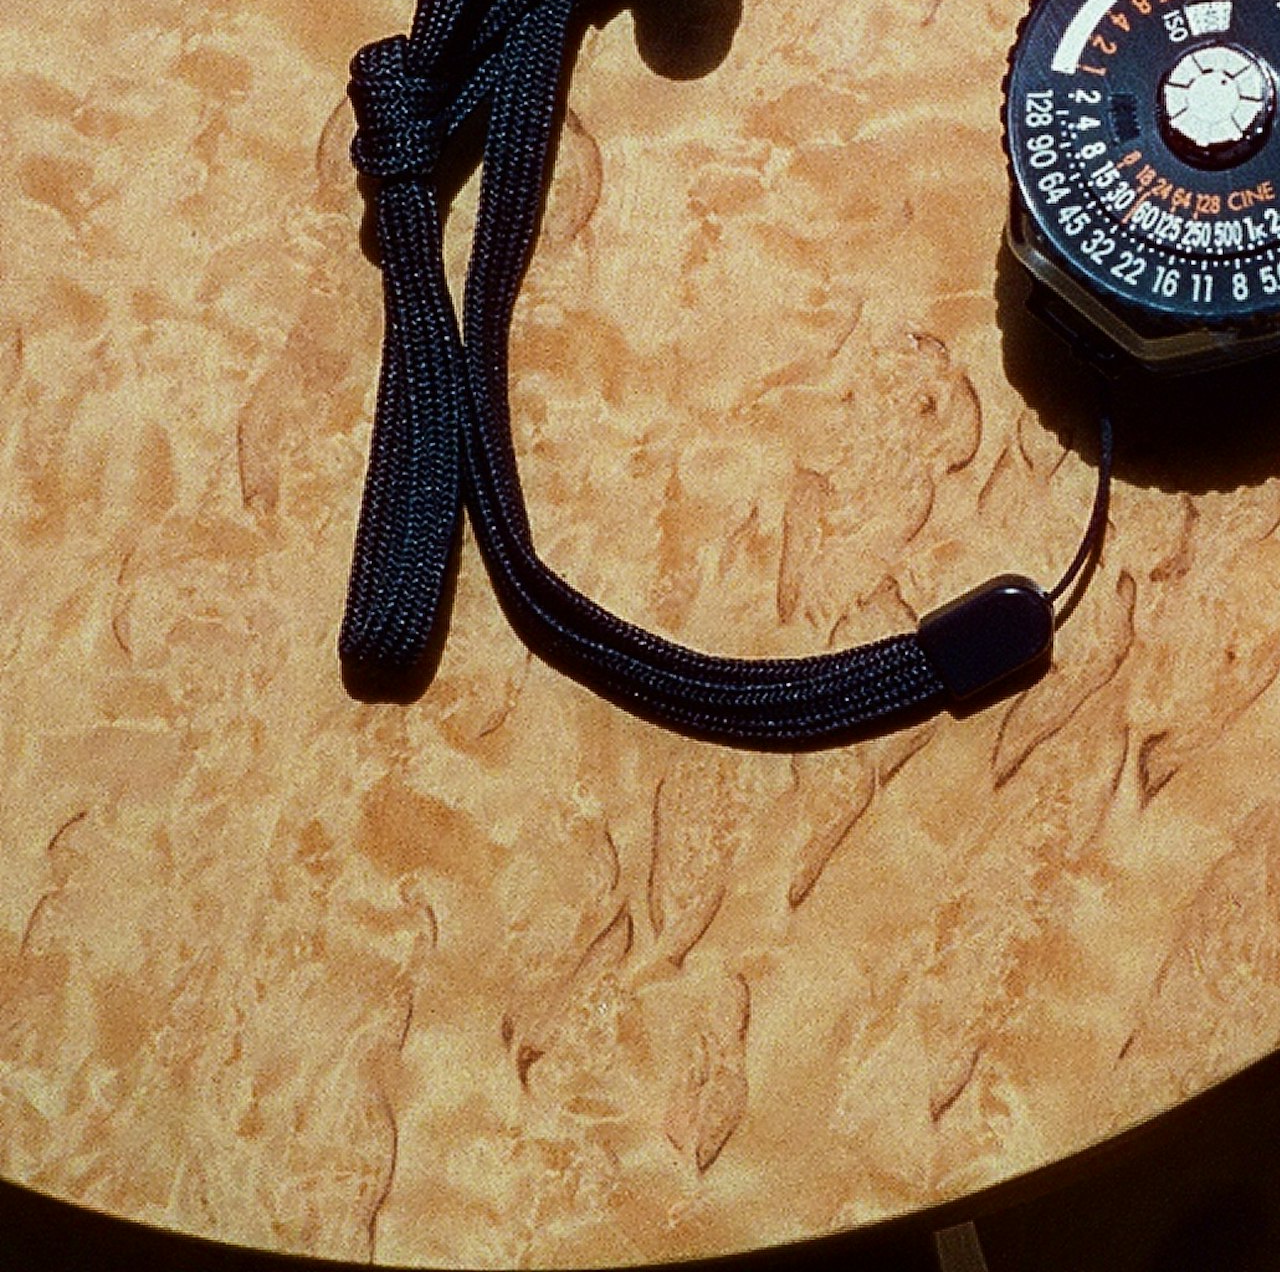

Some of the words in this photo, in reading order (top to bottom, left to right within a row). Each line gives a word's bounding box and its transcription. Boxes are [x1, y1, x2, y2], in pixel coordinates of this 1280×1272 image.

[1092, 34, 1118, 55] 2
[1108, 12, 1132, 32] 4
[1162, 9, 1189, 43] ISO
[1026, 88, 1054, 128] 128
[1075, 89, 1101, 104] 2
[1076, 115, 1101, 131] 4
[1026, 134, 1058, 169] 90
[1080, 141, 1107, 160] 8
[1037, 171, 1072, 205] 64
[1090, 160, 1121, 189] 15
[1103, 180, 1136, 210] 30
[1227, 180, 1276, 212] CINE
[1057, 204, 1092, 237] 45
[1131, 200, 1160, 230] 60
[1153, 210, 1184, 242] 125
[1080, 229, 1116, 266] 32
[1181, 220, 1212, 248] 250
[1214, 220, 1243, 247] 500
[1110, 250, 1148, 286] 22
[1152, 264, 1180, 297] 16
[1190, 273, 1213, 303] 11
[1232, 272, 1249, 301] 8
